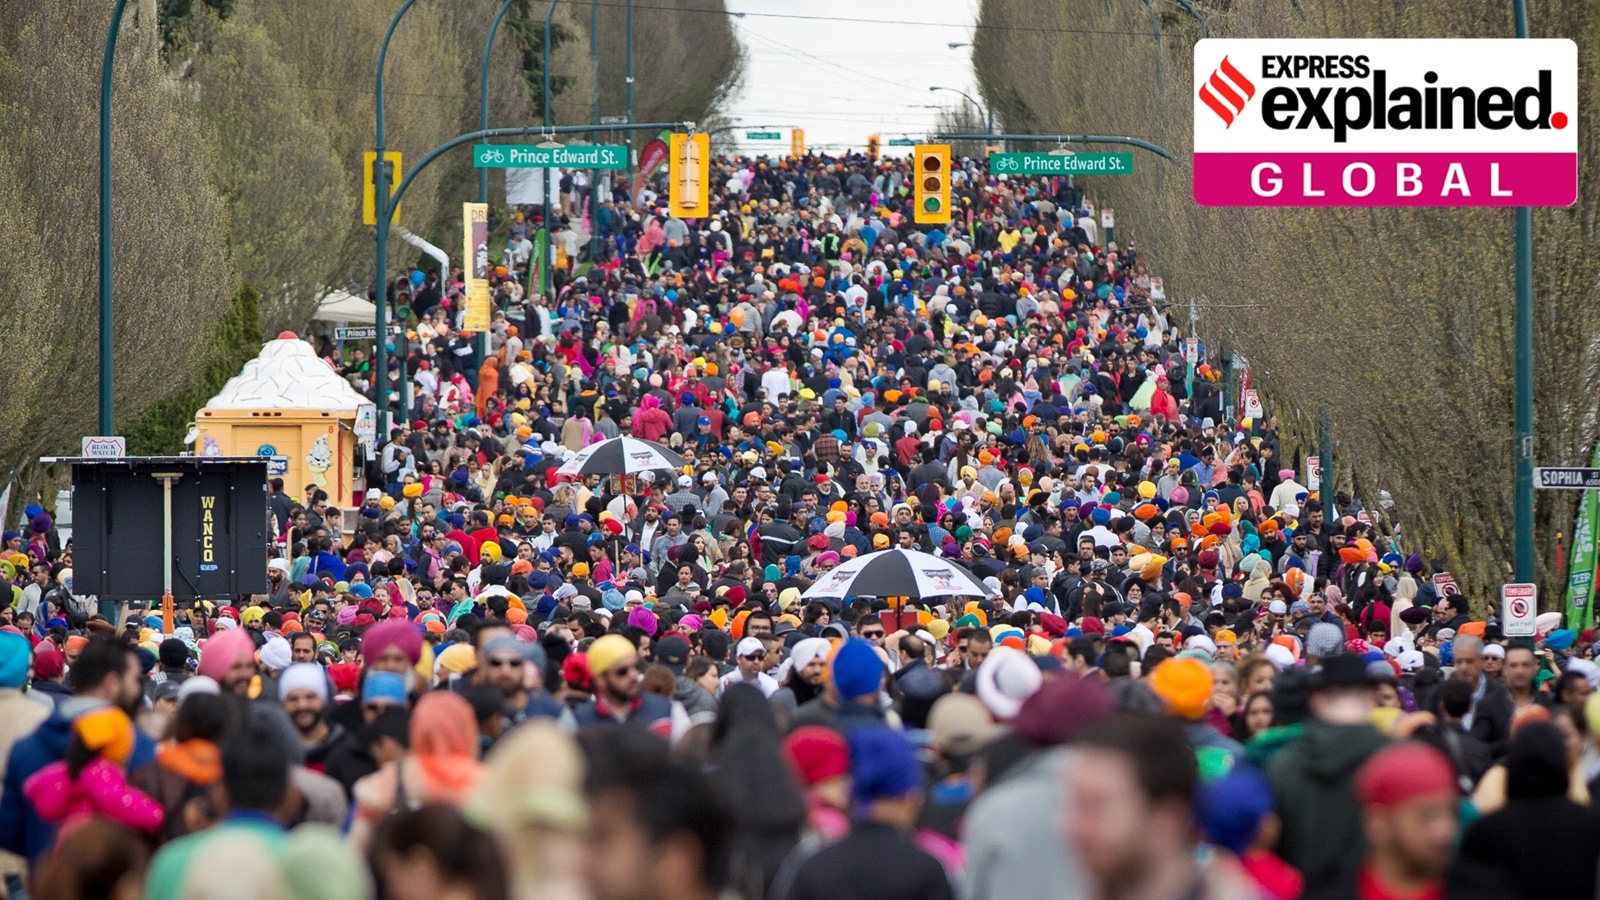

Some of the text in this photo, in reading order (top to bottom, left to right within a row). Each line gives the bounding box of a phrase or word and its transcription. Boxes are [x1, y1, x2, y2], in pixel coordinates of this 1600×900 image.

[510, 149, 619, 164] Prince Edward St.
[1024, 156, 1125, 170] Prince Edward St.
[328, 425, 334, 434] 8
[1543, 470, 1583, 484] SOPHIA
[201, 496, 216, 562] WANCO
[1571, 572, 1591, 584] ZER
